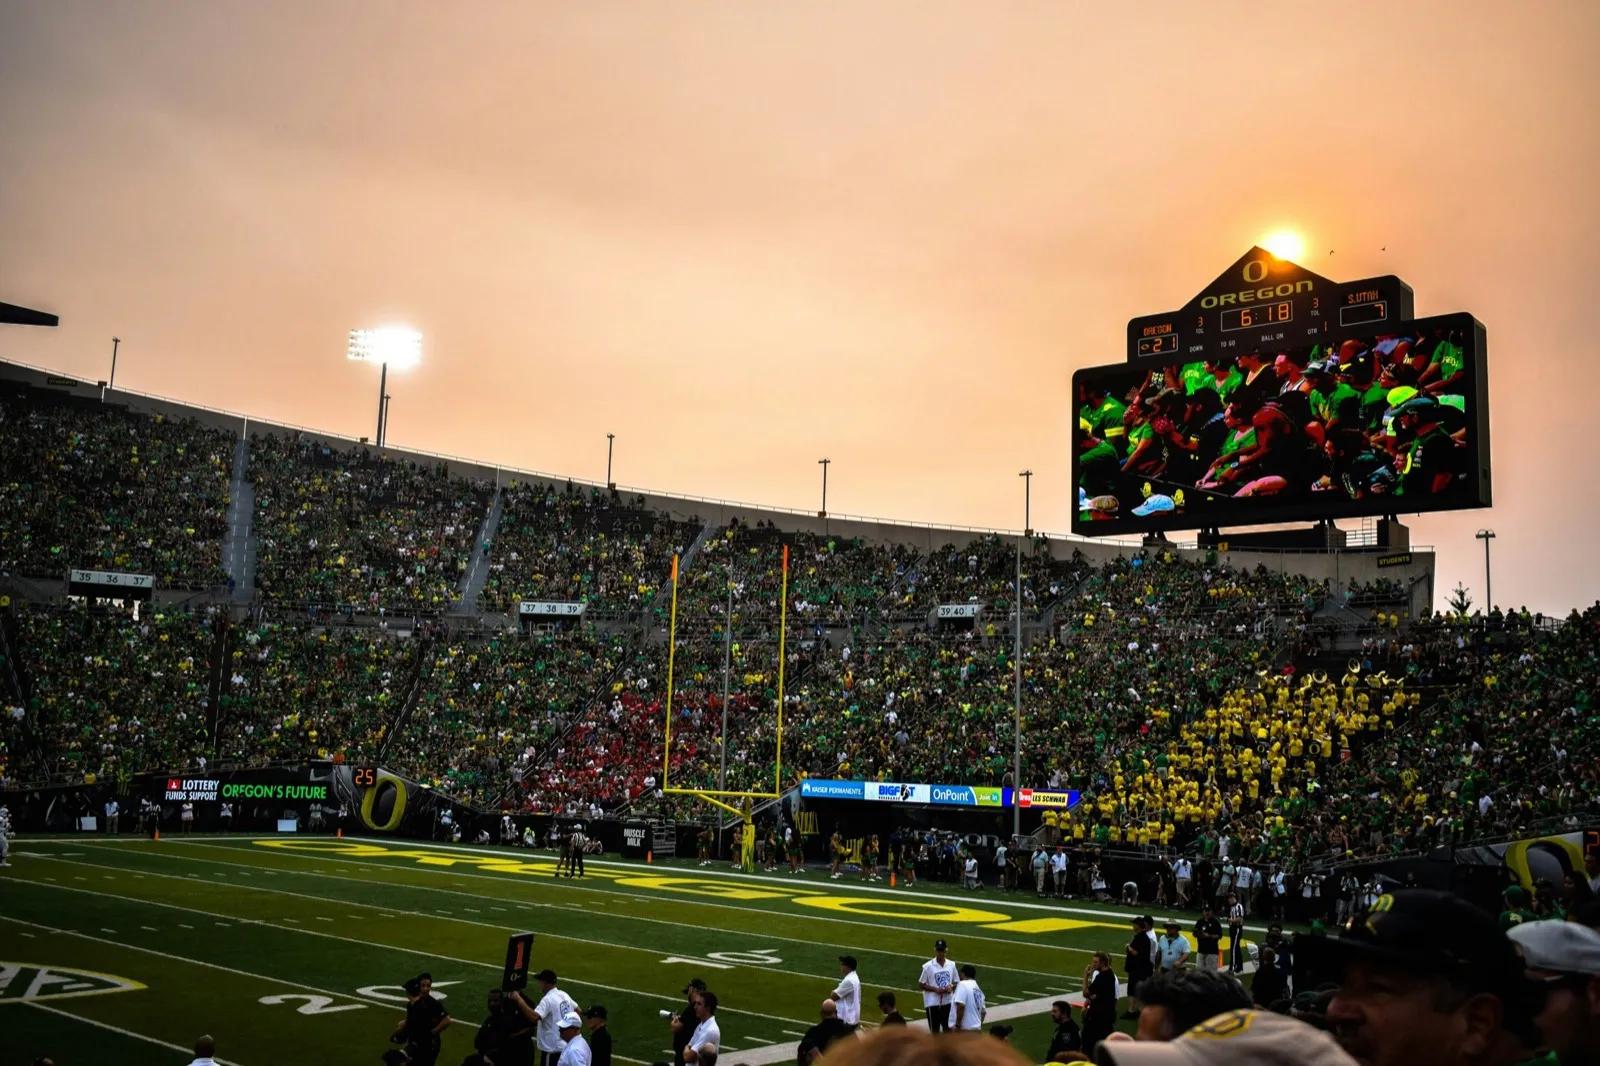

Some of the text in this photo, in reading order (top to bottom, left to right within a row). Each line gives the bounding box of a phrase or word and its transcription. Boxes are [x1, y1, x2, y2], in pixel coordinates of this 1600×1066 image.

[1243, 260, 1268, 283] O
[1200, 280, 1313, 309] OREGON
[1348, 290, 1379, 304] S.UTAH
[1313, 297, 1319, 309] 3
[1241, 303, 1289, 327] 6:18
[1374, 303, 1384, 317] 7
[1198, 316, 1204, 328] 3
[1143, 323, 1172, 337] OREGON
[1261, 332, 1284, 342] BALL ON
[1189, 344, 1204, 353] DOWN
[1379, 555, 1410, 565] STUDENTS
[79, 573, 145, 586] 35 36 37
[525, 603, 578, 613] 37 38 39
[940, 607, 951, 616] 39
[953, 607, 965, 616] 40
[355, 768, 374, 785] 25
[182, 779, 220, 791] LOTTERY
[811, 786, 828, 794] KAISER
[165, 791, 218, 801] FUNDS SUPPORT
[222, 784, 327, 799] OREGON'S FUTURE
[933, 788, 968, 802] OnPoint
[1032, 794, 1066, 804] LES SCHWAB
[623, 828, 646, 838] MUSCLE
[627, 837, 641, 847] MILK
